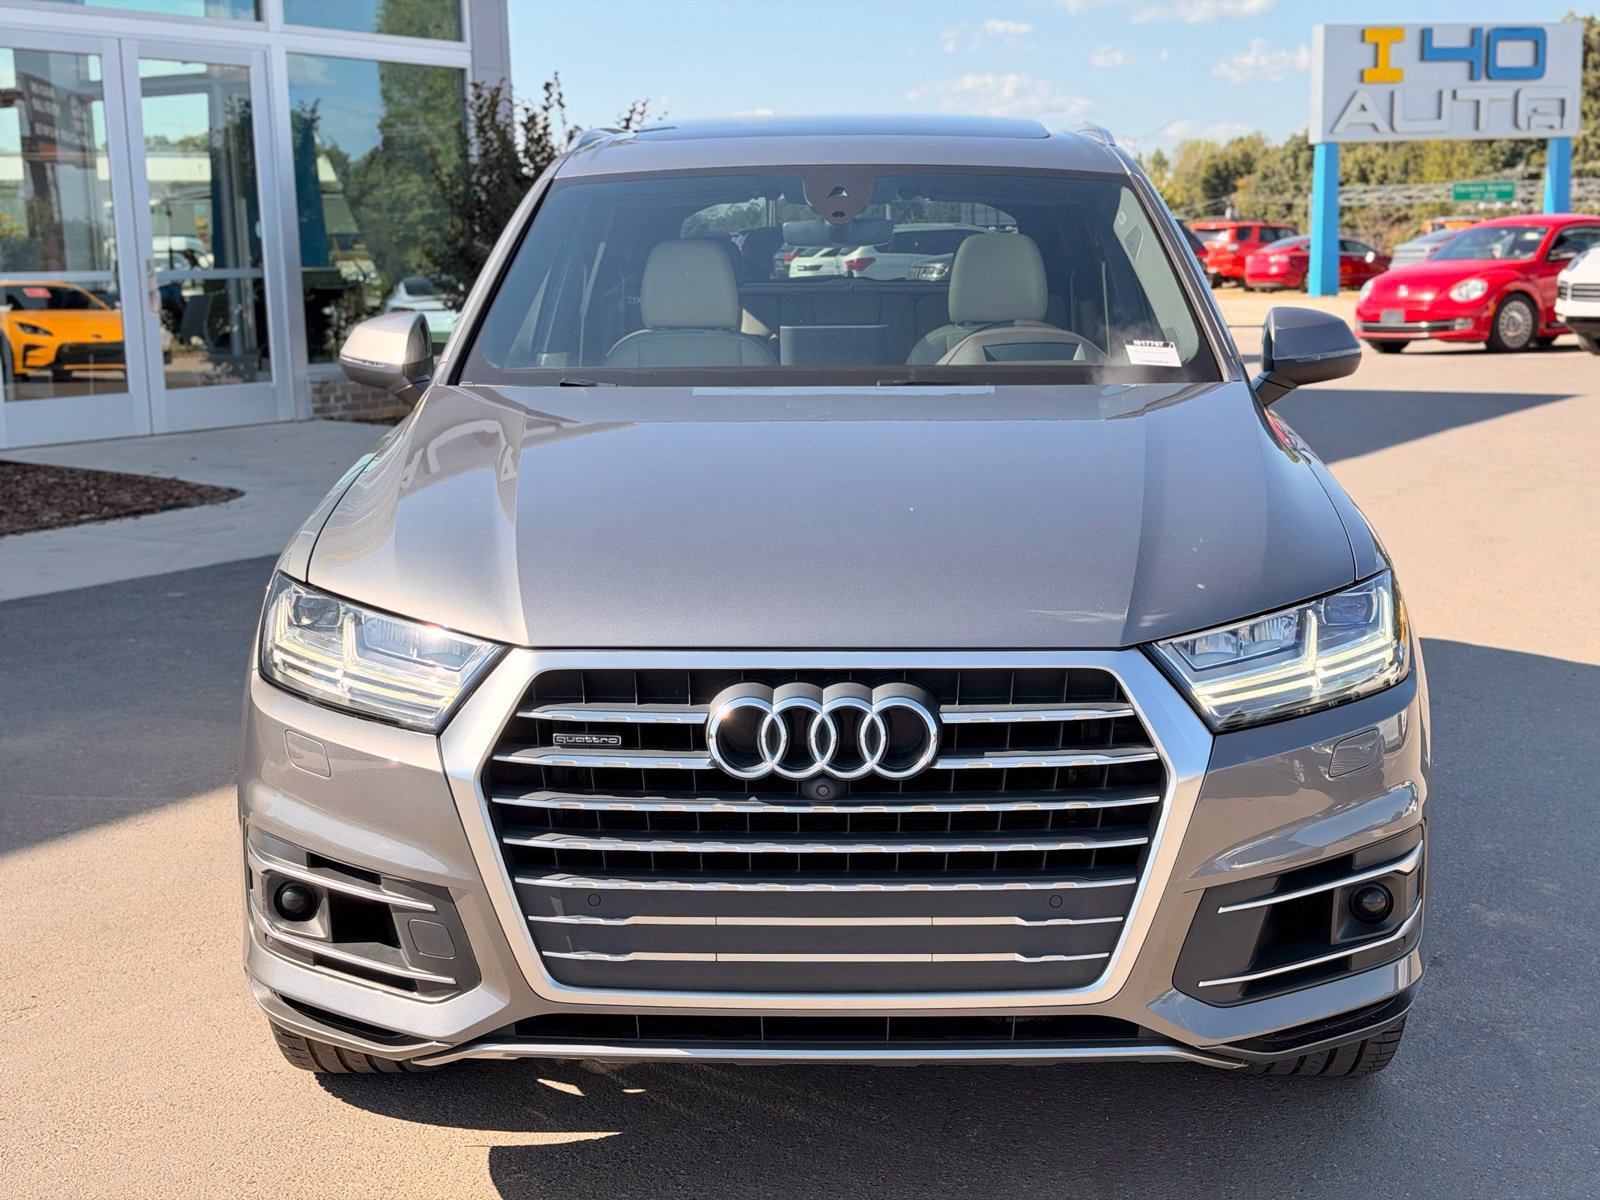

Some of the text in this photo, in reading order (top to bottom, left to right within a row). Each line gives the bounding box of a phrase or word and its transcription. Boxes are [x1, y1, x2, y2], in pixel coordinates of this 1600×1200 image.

[1361, 27, 1547, 83] I 40
[556, 736, 618, 744] quattro
